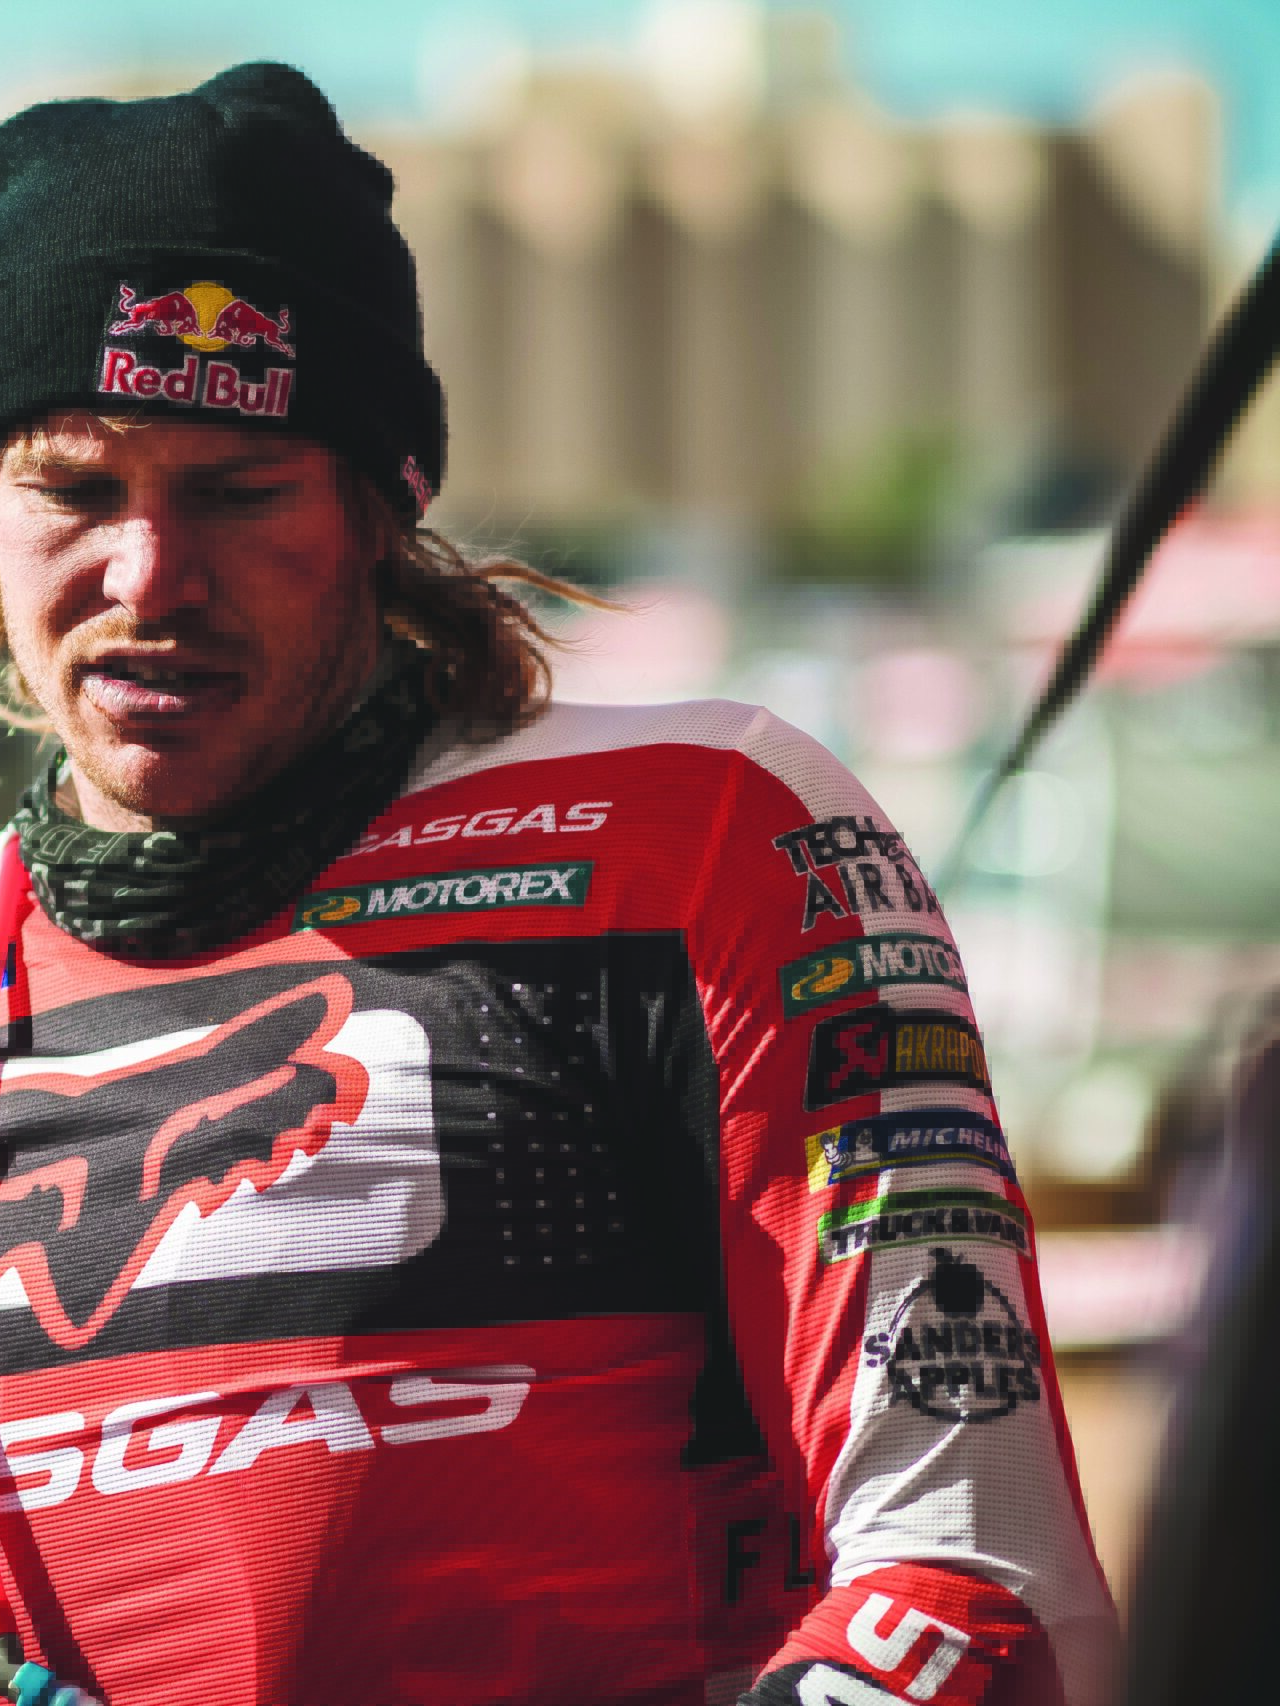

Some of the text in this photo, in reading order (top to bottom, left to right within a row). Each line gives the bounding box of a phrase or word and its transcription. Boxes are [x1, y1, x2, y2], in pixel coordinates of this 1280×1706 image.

[98, 346, 293, 417] Red Bull
[364, 867, 577, 916] MOTOREX
[801, 863, 896, 934] AIR
[888, 1127, 1009, 1163] MICHELIN
[864, 1319, 1041, 1368] SANDERS
